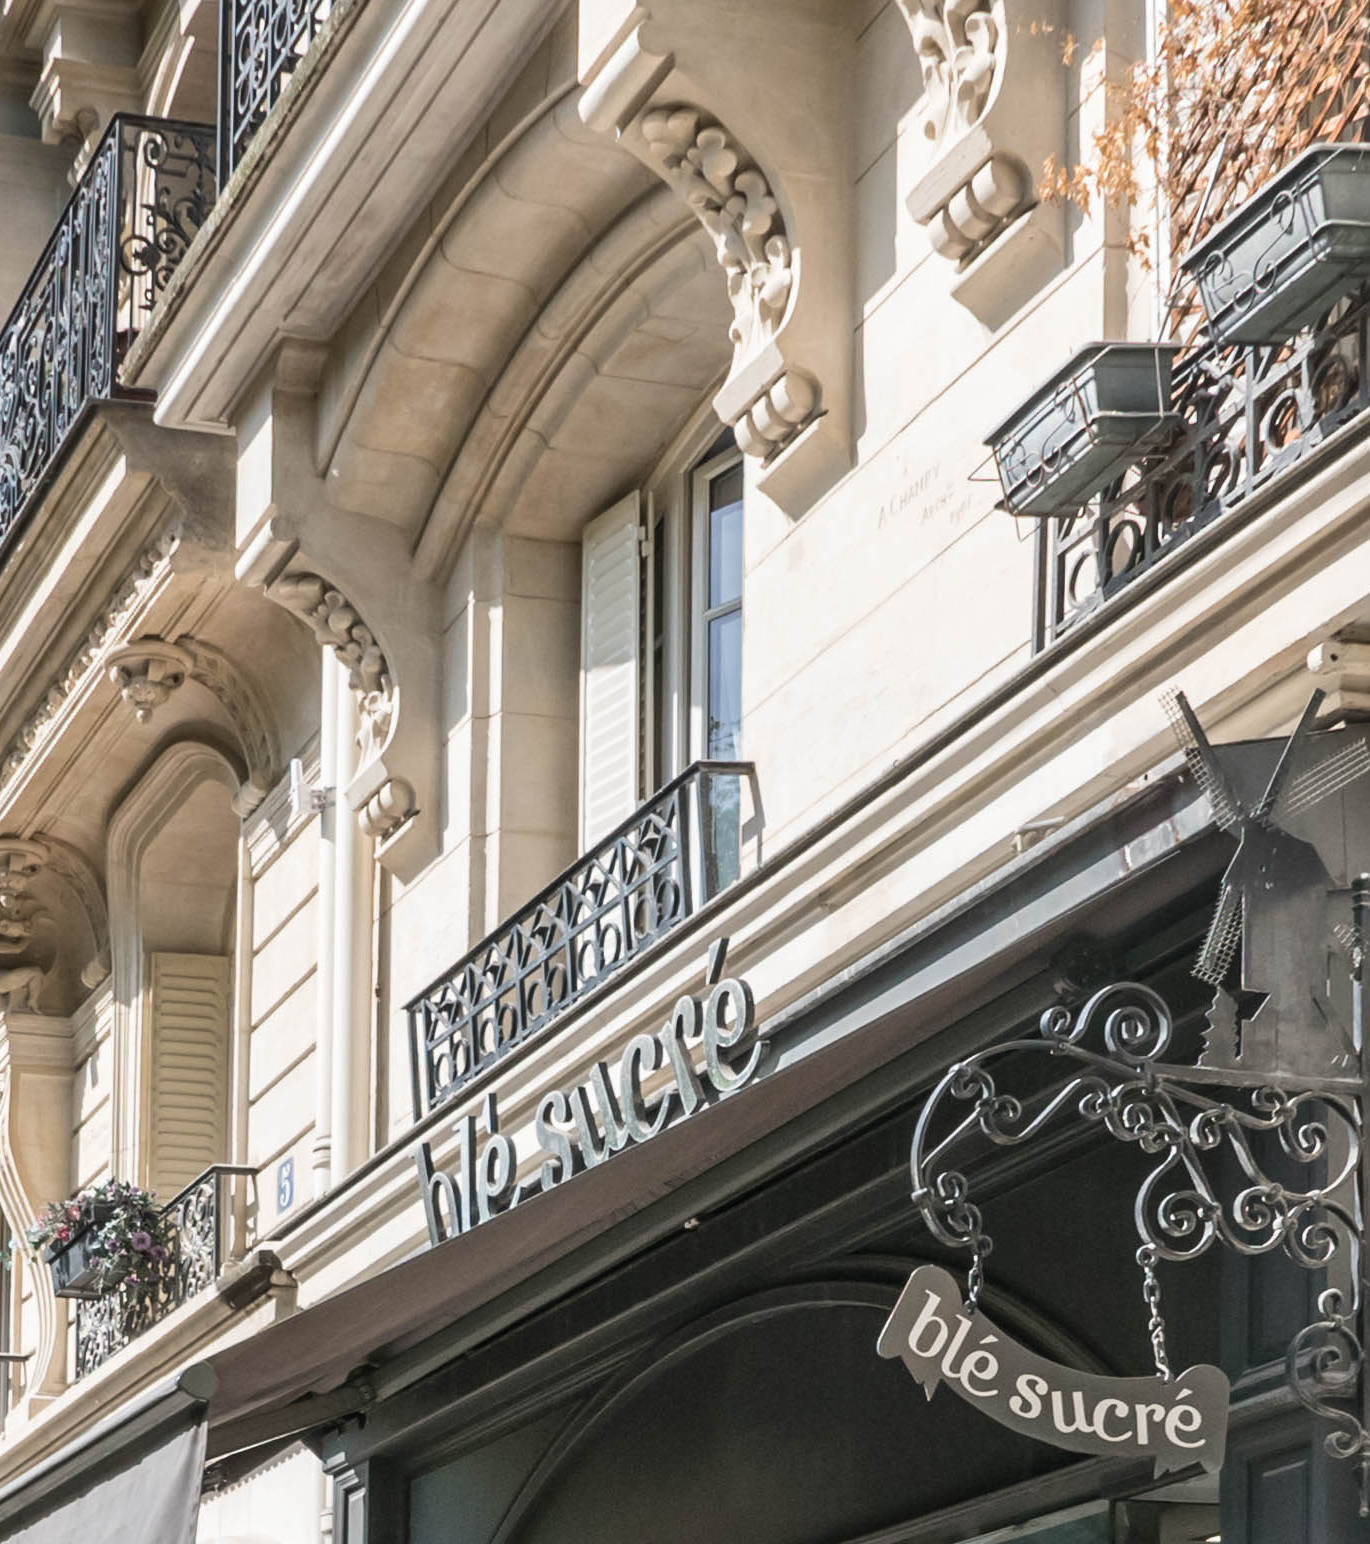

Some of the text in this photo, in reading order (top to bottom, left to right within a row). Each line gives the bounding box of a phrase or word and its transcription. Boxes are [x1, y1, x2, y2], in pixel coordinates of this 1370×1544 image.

[408, 937, 770, 1247] blé sucré
[279, 1162, 291, 1207] 5
[907, 1289, 1207, 1449] blé sucré
